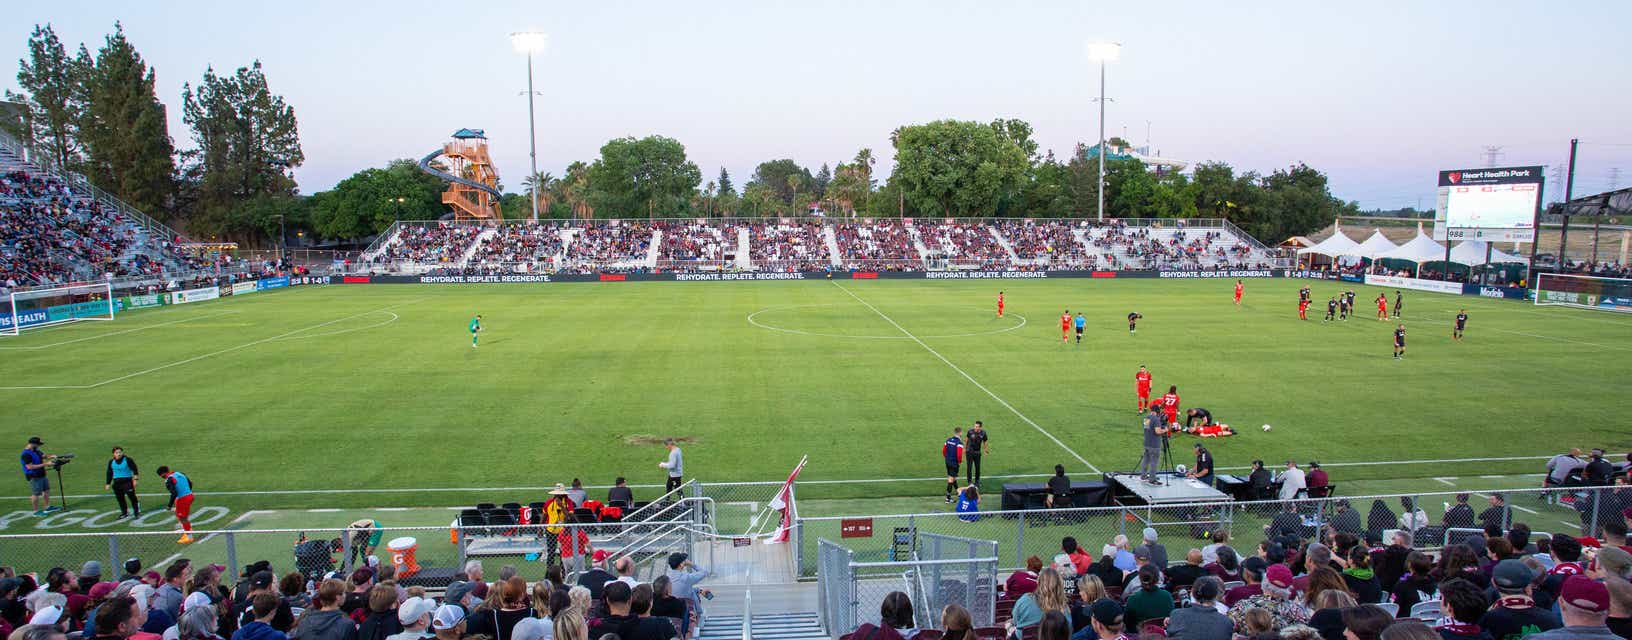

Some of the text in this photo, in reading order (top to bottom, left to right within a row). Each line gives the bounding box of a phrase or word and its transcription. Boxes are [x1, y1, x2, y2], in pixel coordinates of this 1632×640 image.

[1484, 170, 1510, 178] Health
[1511, 169, 1530, 177] Park
[676, 273, 721, 281] REHYDRATE.
[926, 271, 969, 279] REHYDRATE.
[1165, 397, 1177, 406] 27
